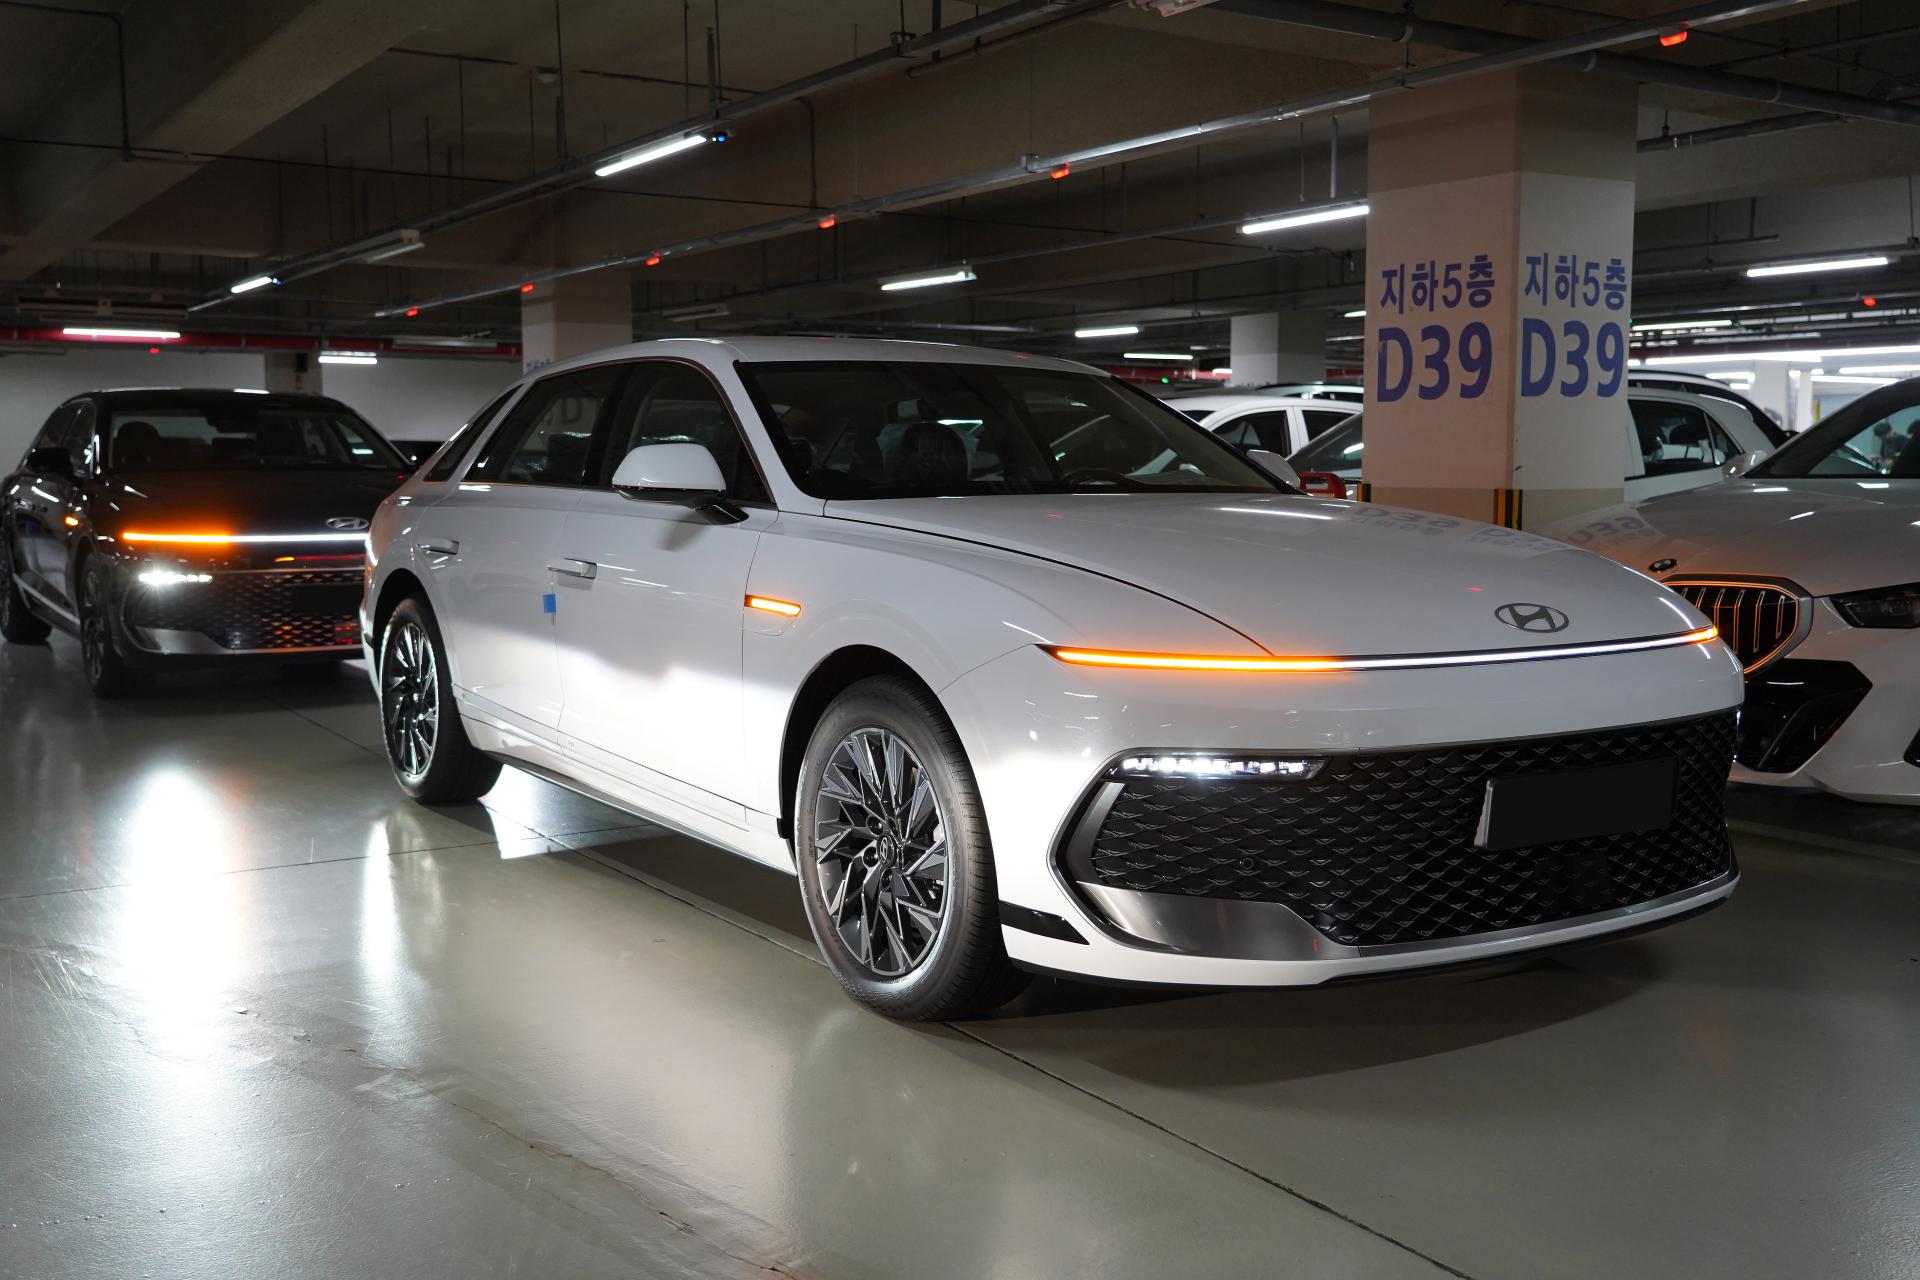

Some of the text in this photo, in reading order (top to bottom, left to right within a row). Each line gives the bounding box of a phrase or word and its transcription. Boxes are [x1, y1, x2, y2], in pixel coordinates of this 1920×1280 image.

[1380, 254, 1495, 314] 지하5층
[1524, 252, 1627, 310] 지하5층
[1377, 321, 1492, 402] D39
[1521, 318, 1624, 398] D39
